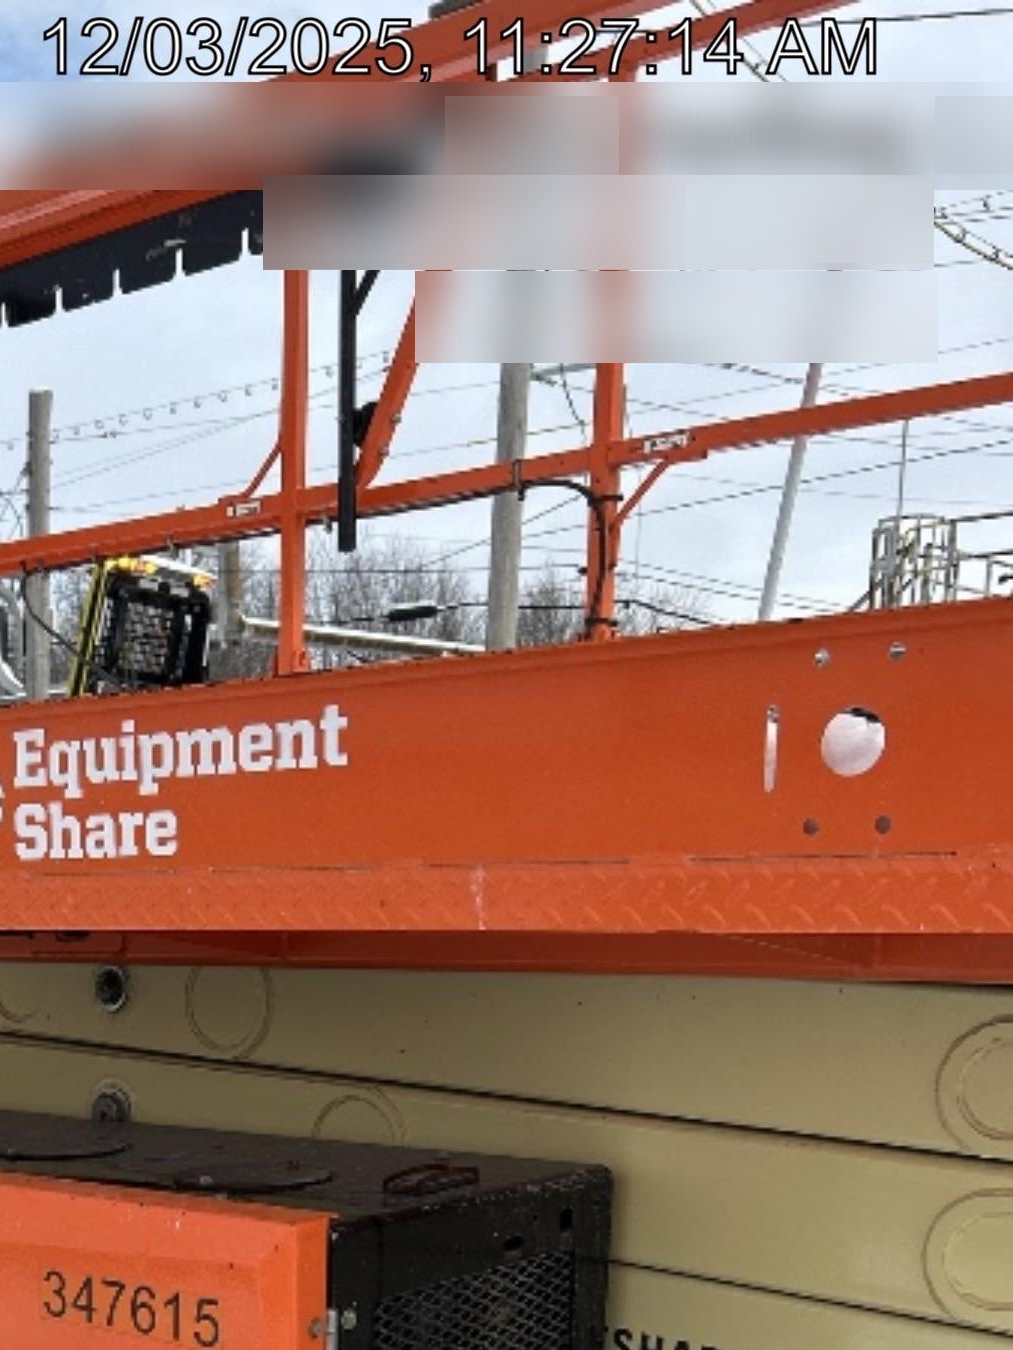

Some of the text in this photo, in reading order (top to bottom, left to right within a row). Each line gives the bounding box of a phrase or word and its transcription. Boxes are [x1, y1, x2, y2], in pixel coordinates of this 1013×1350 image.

[13, 704, 349, 799] Equipment
[14, 802, 178, 861] Share
[43, 1270, 220, 1348] 347615
